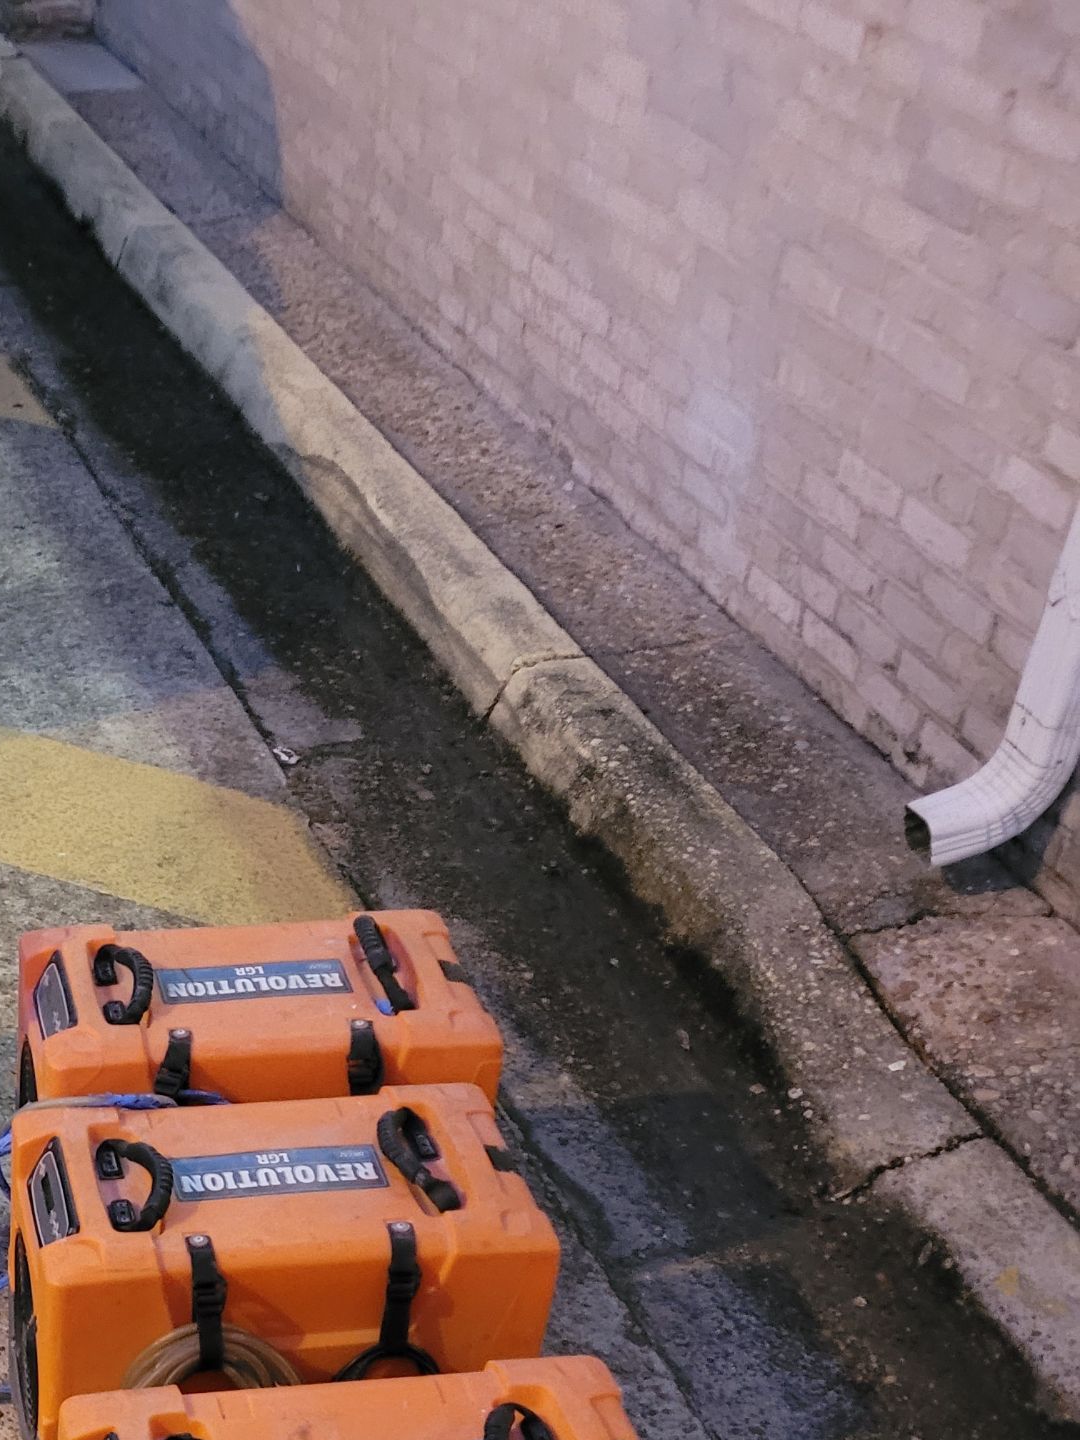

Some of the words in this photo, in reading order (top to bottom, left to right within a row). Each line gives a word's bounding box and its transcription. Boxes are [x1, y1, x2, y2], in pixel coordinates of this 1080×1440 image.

[234, 965, 265, 976] LGR
[167, 972, 344, 998] REVOLUTION
[255, 1152, 290, 1165] LGR
[181, 1162, 379, 1193] REVOLUTION
